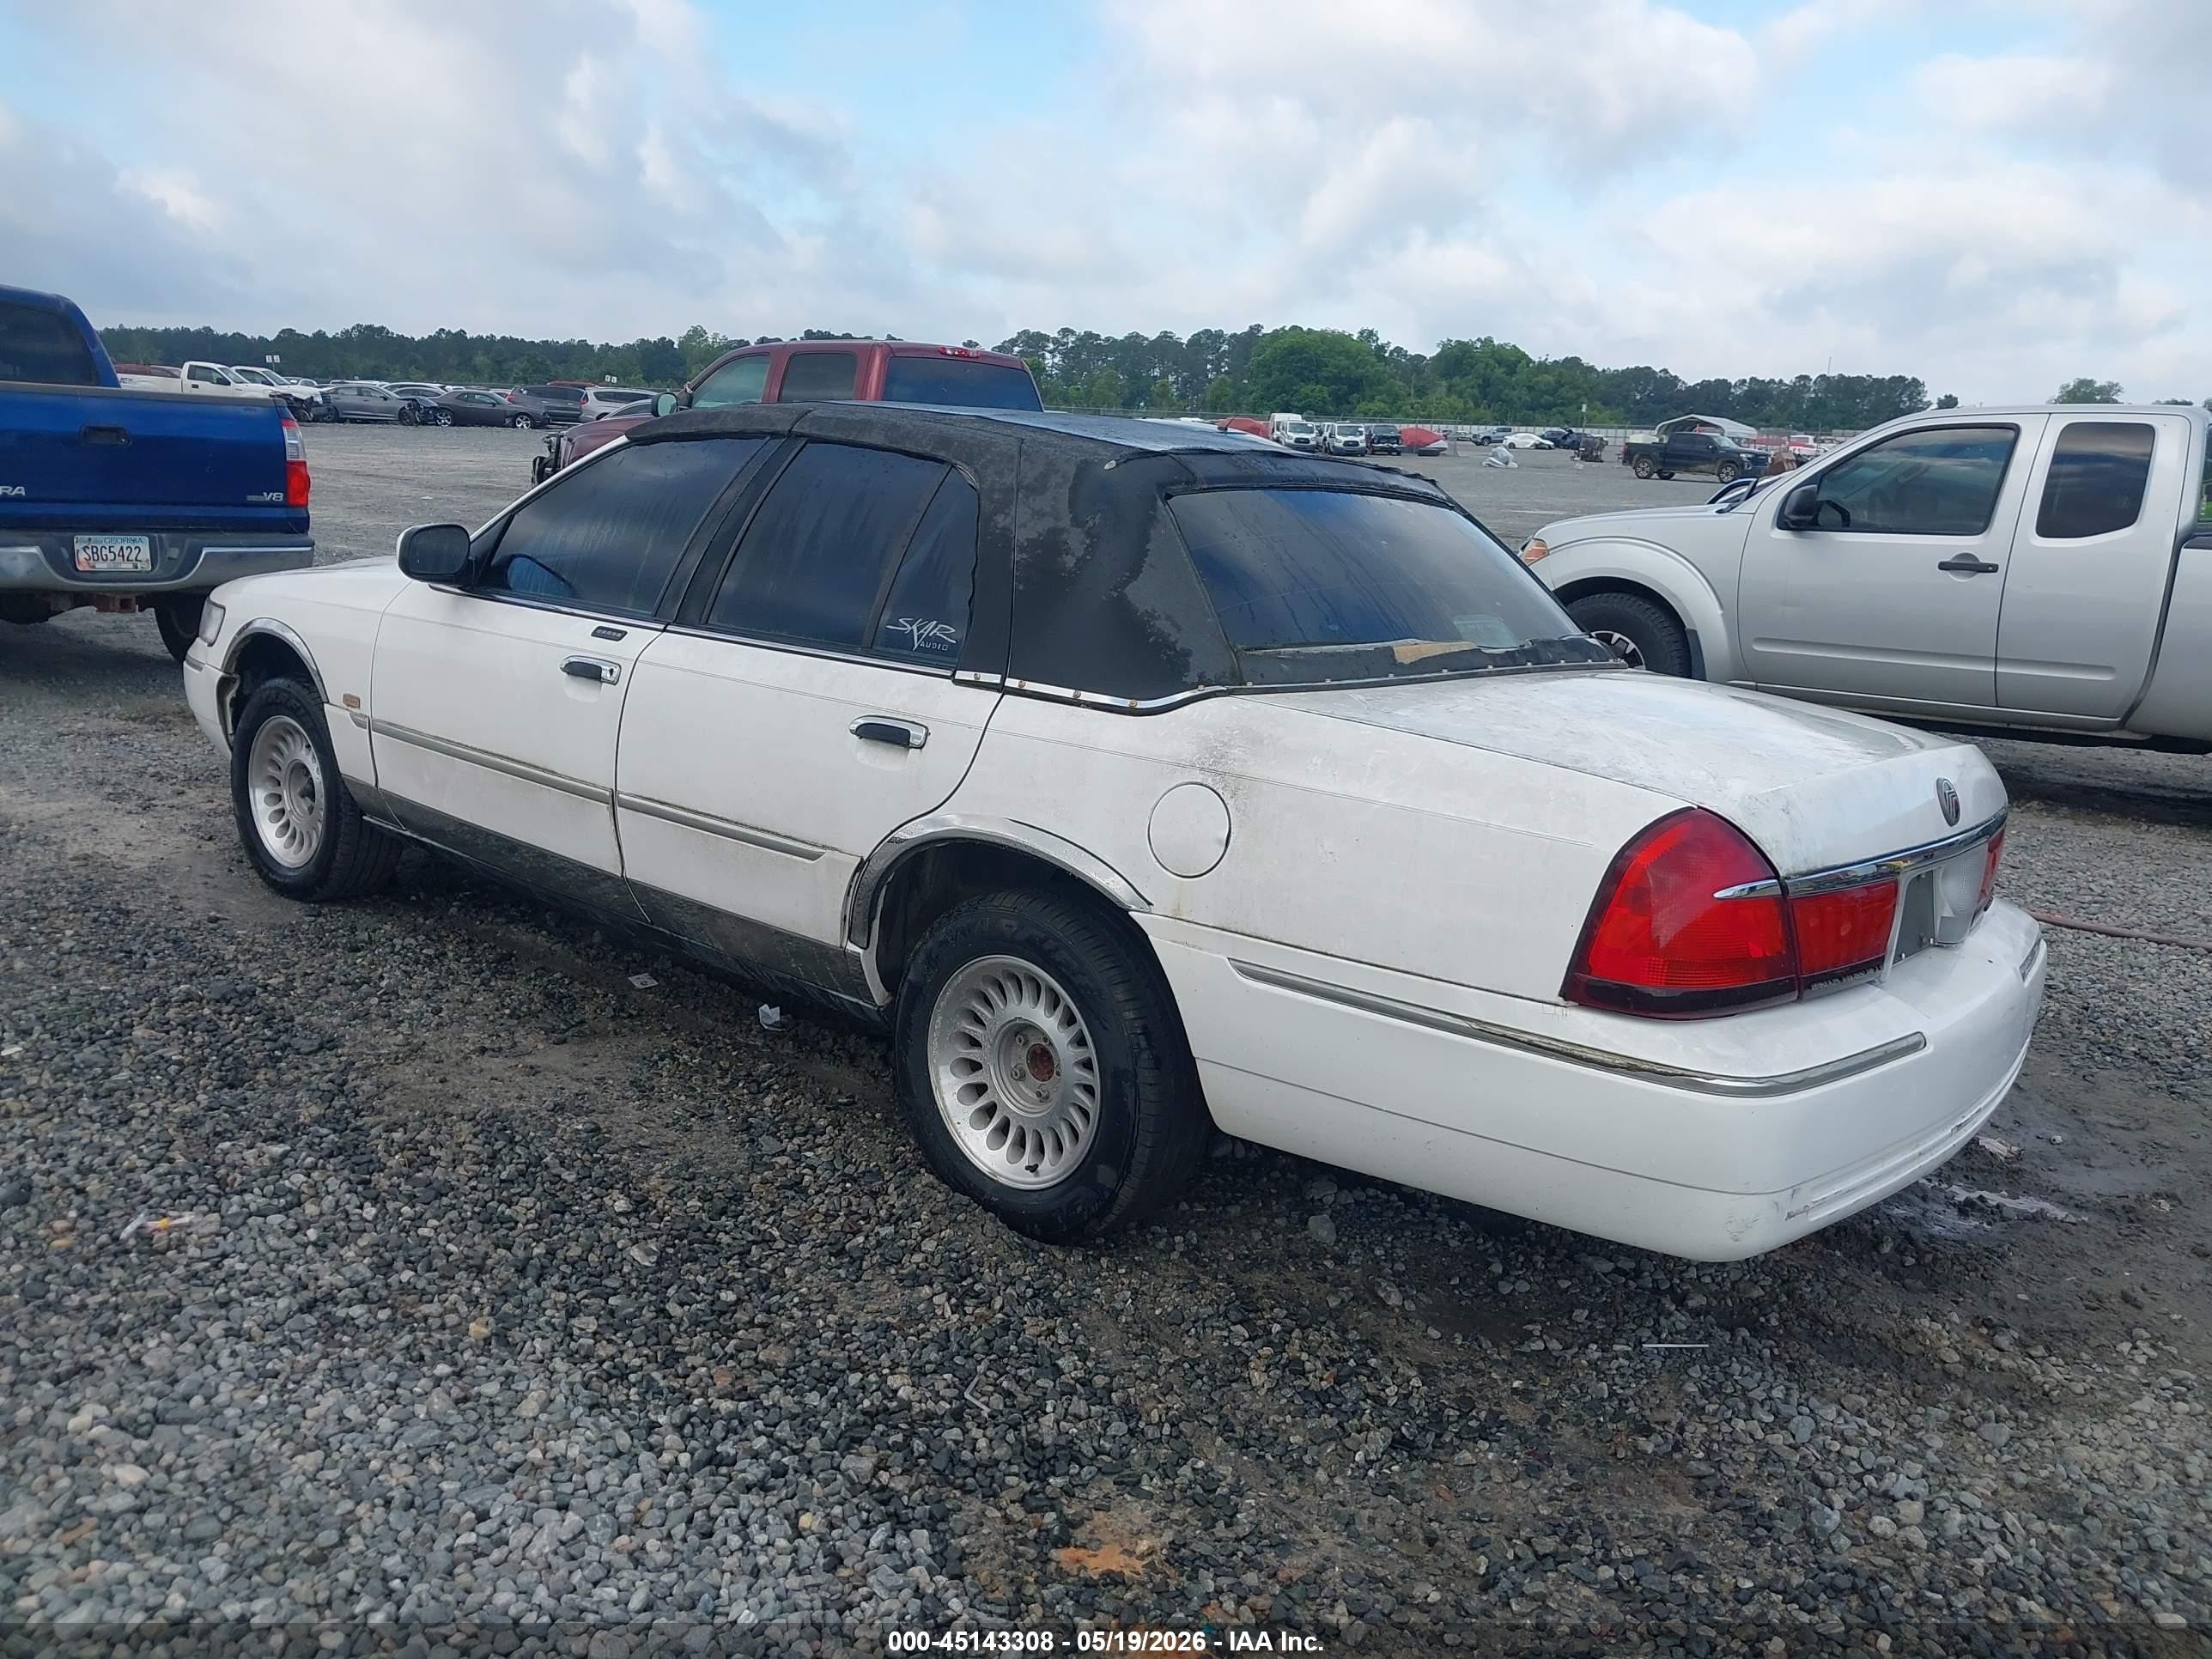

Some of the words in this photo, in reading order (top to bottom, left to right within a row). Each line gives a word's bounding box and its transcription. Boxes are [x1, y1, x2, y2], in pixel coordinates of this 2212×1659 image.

[263, 491, 284, 502] V8
[82, 545, 143, 562] SBG5422
[886, 618, 957, 651] SKAR
[919, 641, 950, 652] AUDIO
